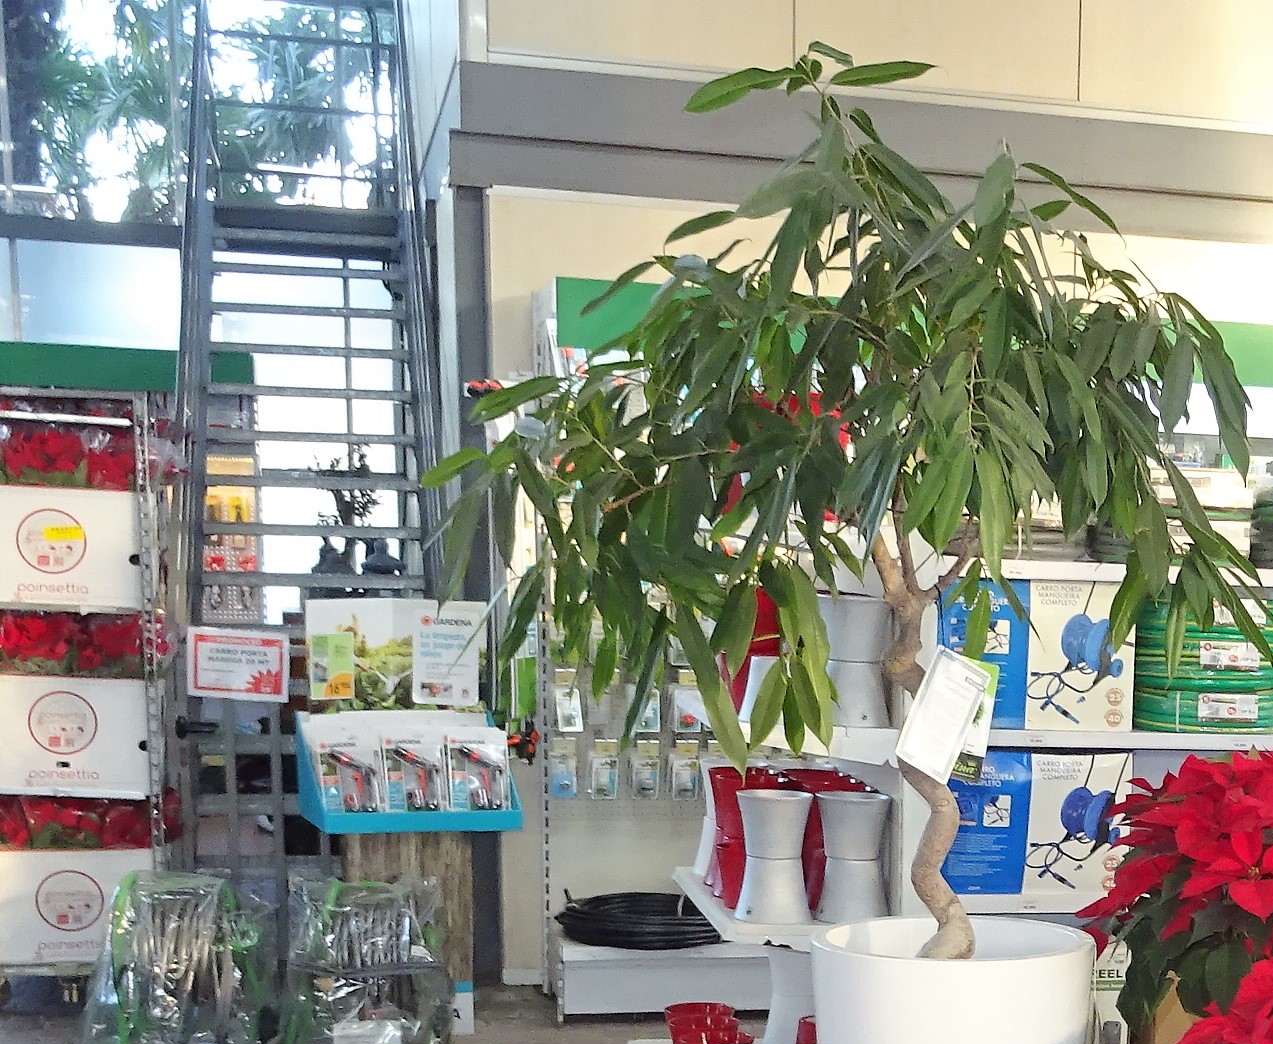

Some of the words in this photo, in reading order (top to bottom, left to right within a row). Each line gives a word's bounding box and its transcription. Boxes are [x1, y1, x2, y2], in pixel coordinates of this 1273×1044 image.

[17, 582, 89, 596] poinsettia
[433, 618, 472, 627] GARDENA
[28, 768, 100, 782] poinsettia
